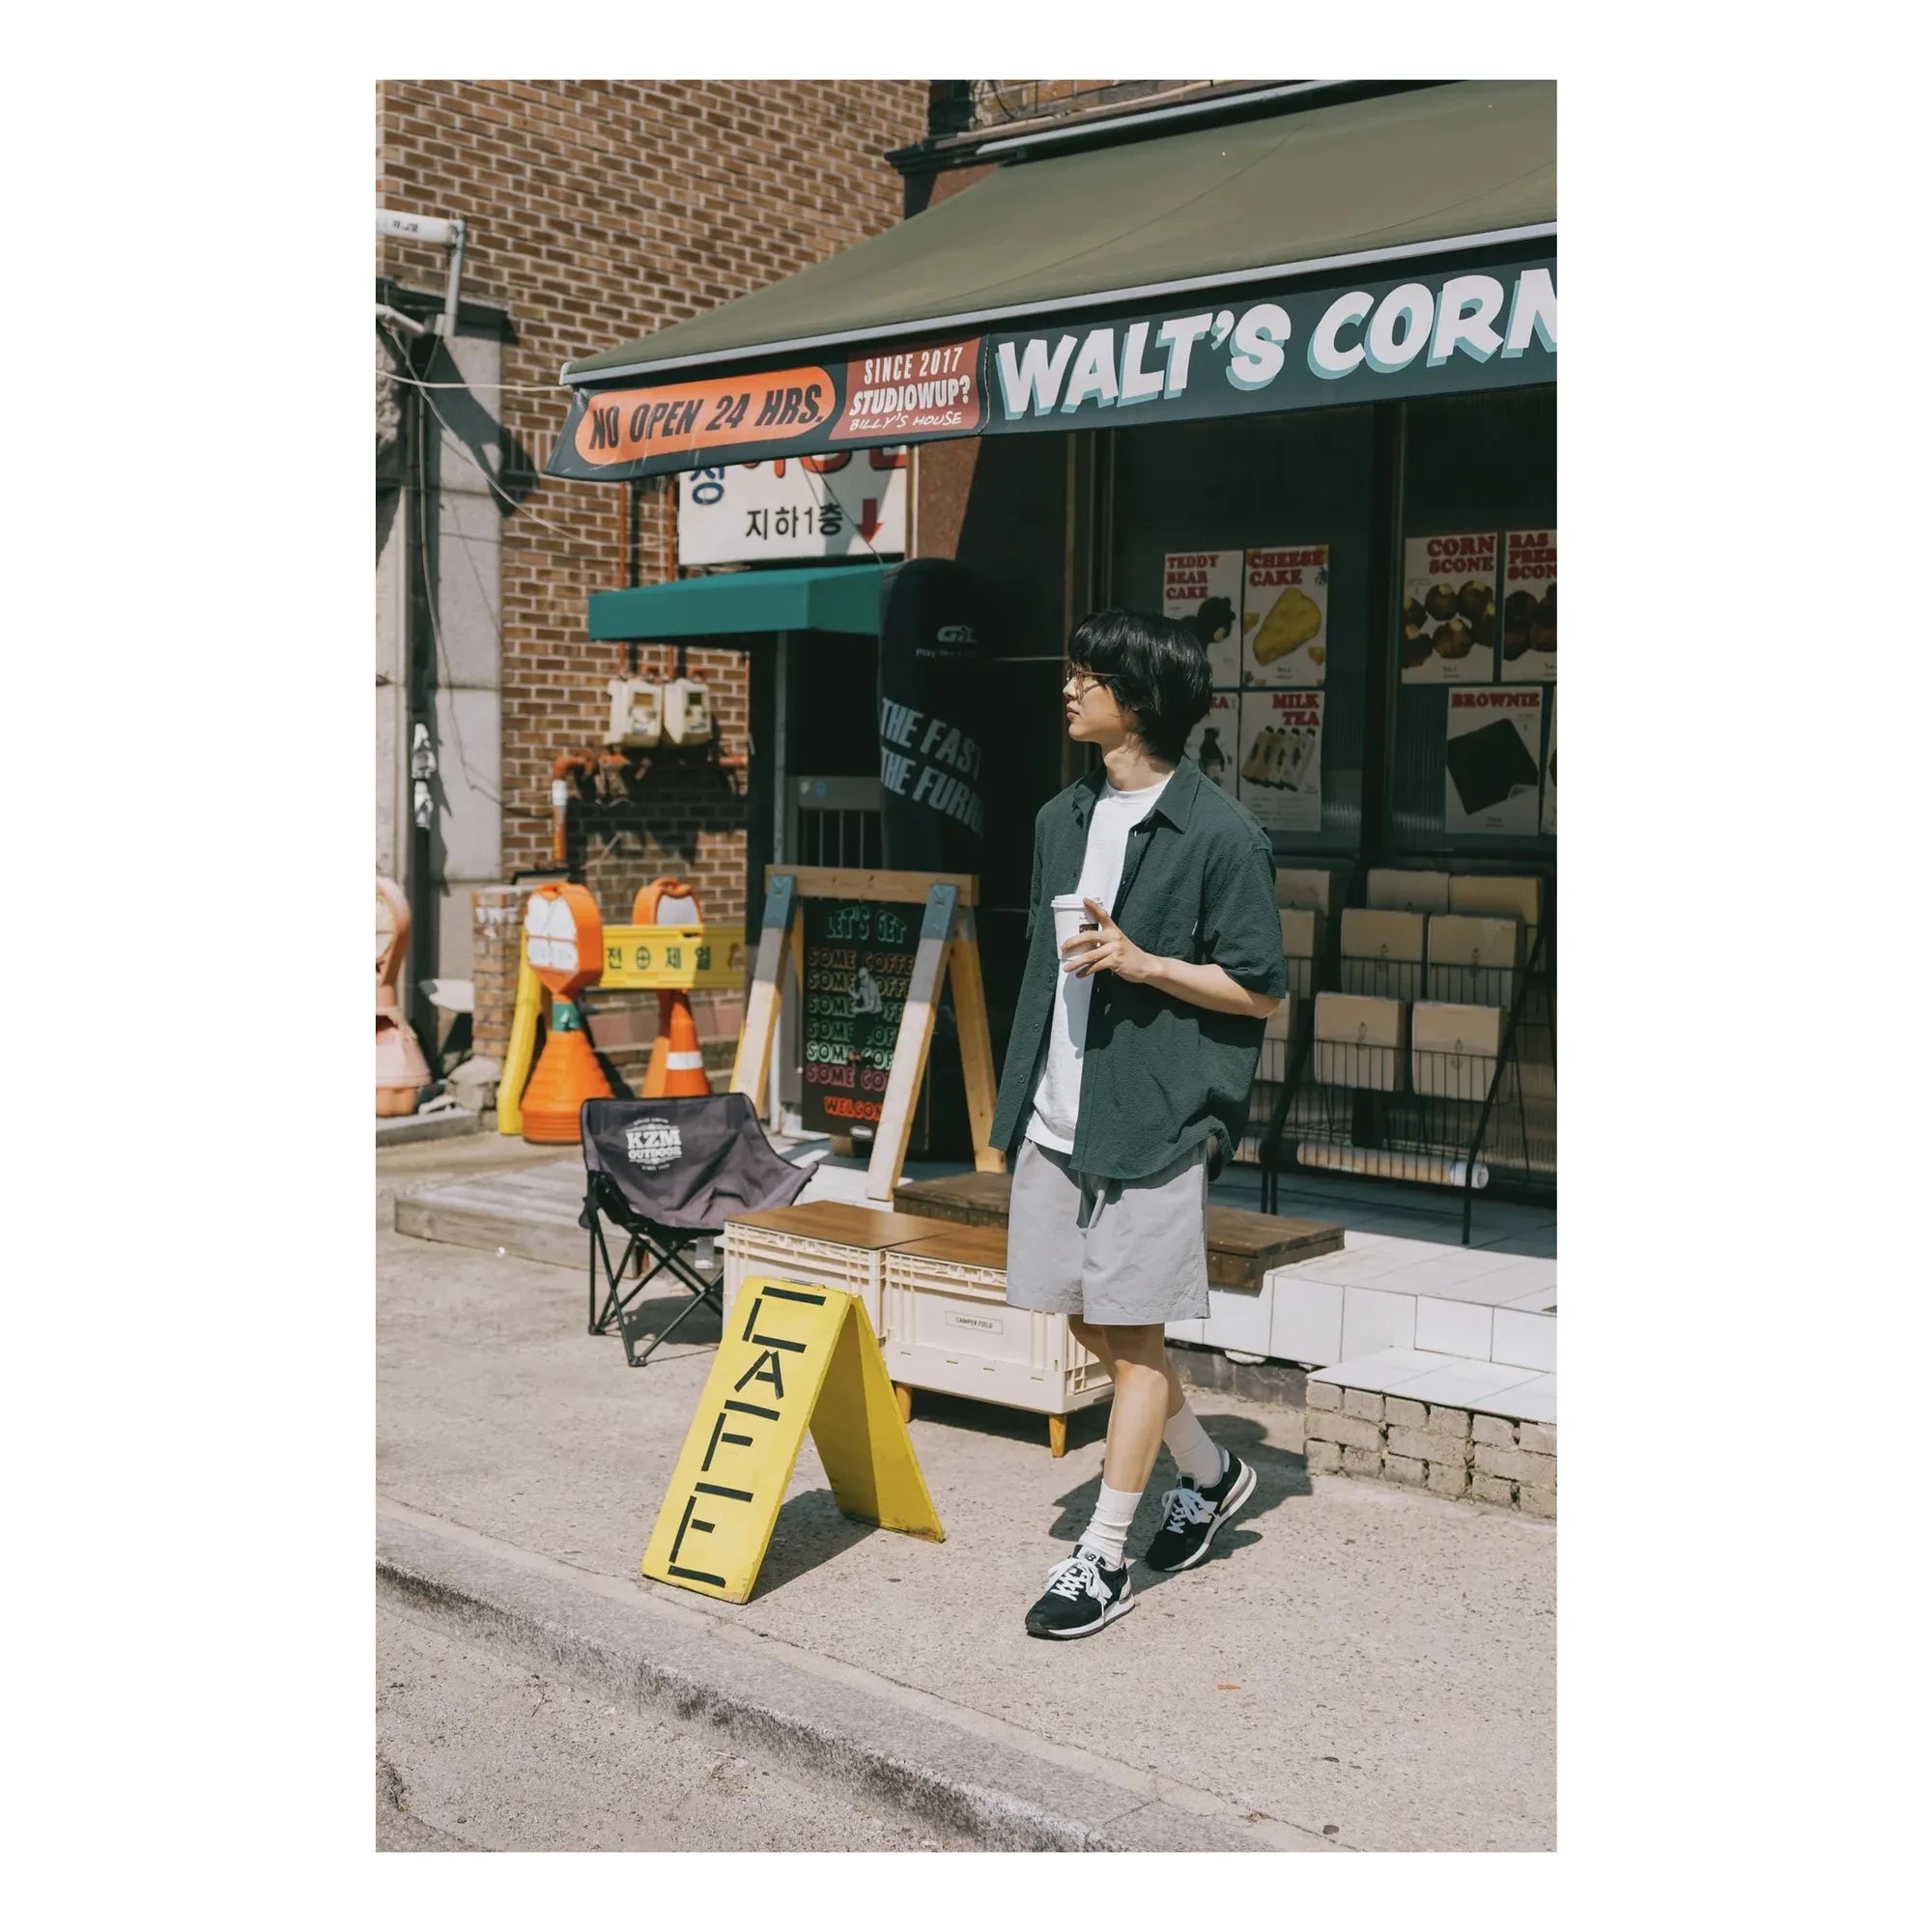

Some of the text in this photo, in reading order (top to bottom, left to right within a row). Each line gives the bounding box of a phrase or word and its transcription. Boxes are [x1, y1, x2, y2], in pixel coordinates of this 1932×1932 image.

[864, 347, 963, 384] SINCE 2017
[995, 303, 1292, 419] WALT'S
[849, 375, 971, 416] STUDIOWUP?
[588, 384, 824, 450] NO OPEN 24 HRS.
[850, 411, 962, 431] BILLY'S HOUSE
[746, 502, 843, 541] 지하1층
[1427, 536, 1495, 557] CORN
[1509, 533, 1548, 548] RAS
[1166, 554, 1219, 569] TEDDY
[1248, 551, 1325, 568] CHEESE
[1429, 556, 1494, 574] SCONE
[1165, 569, 1208, 584] BEAR
[1249, 568, 1302, 586] CAKE
[1165, 585, 1208, 600] CAKE
[1272, 694, 1321, 709] MILK
[1451, 693, 1540, 708] BROWNIE
[880, 696, 924, 749] THE
[1282, 711, 1321, 726] TEA
[827, 905, 907, 945] LET'S GET
[808, 947, 857, 970] SOME
[808, 969, 857, 993] SOME
[806, 1064, 855, 1088] SOME
[626, 1128, 682, 1151] KZM
[955, 1316, 978, 1326] CAMPER
[668, 1286, 826, 1589] CAFE
